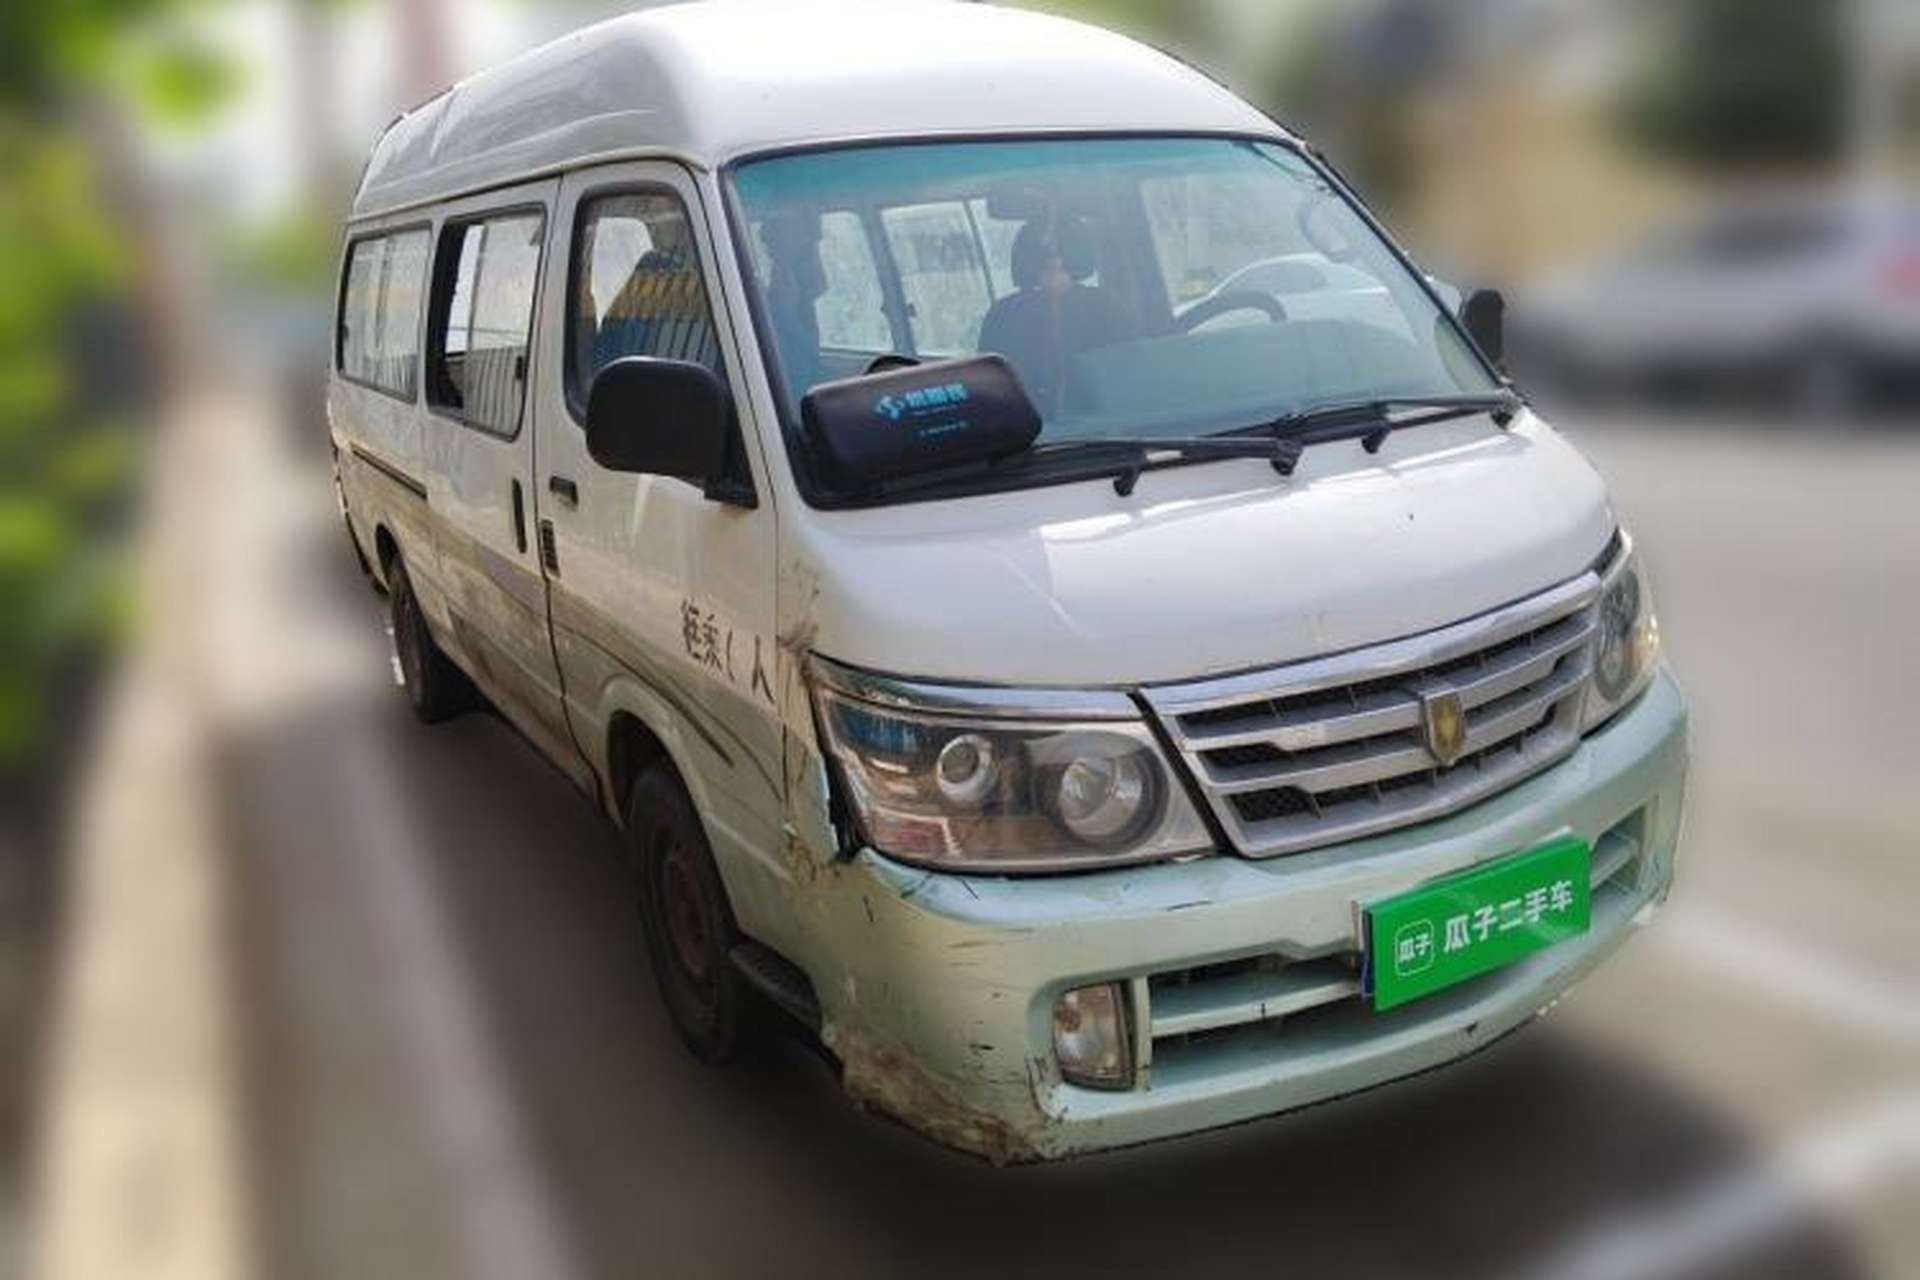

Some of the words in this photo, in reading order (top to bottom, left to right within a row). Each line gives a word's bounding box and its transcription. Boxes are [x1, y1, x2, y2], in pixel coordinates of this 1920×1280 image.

[1444, 880, 1573, 953] 瓜子二手车
[1398, 932, 1432, 964] 瓜子
